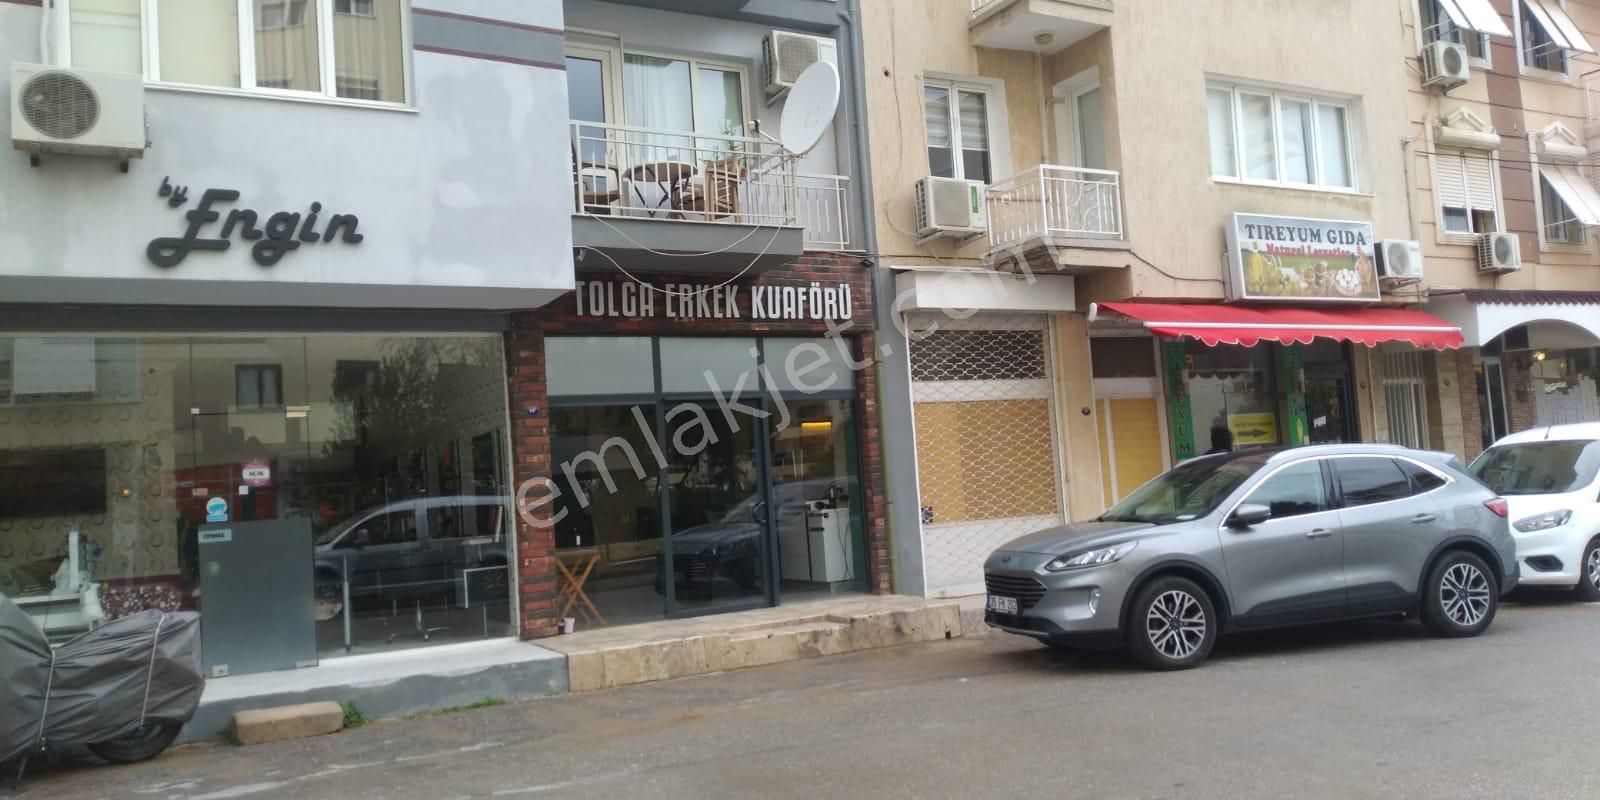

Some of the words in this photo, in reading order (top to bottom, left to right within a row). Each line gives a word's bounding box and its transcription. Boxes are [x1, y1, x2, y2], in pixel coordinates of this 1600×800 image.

[158, 176, 188, 208] by
[146, 188, 364, 268] Engin
[1244, 223, 1322, 243] TIREYUM
[1326, 229, 1367, 246] GIDA
[575, 280, 654, 316] TOLGA
[665, 282, 740, 318] ERKEK
[751, 281, 852, 320] KUAFÖRÜ
